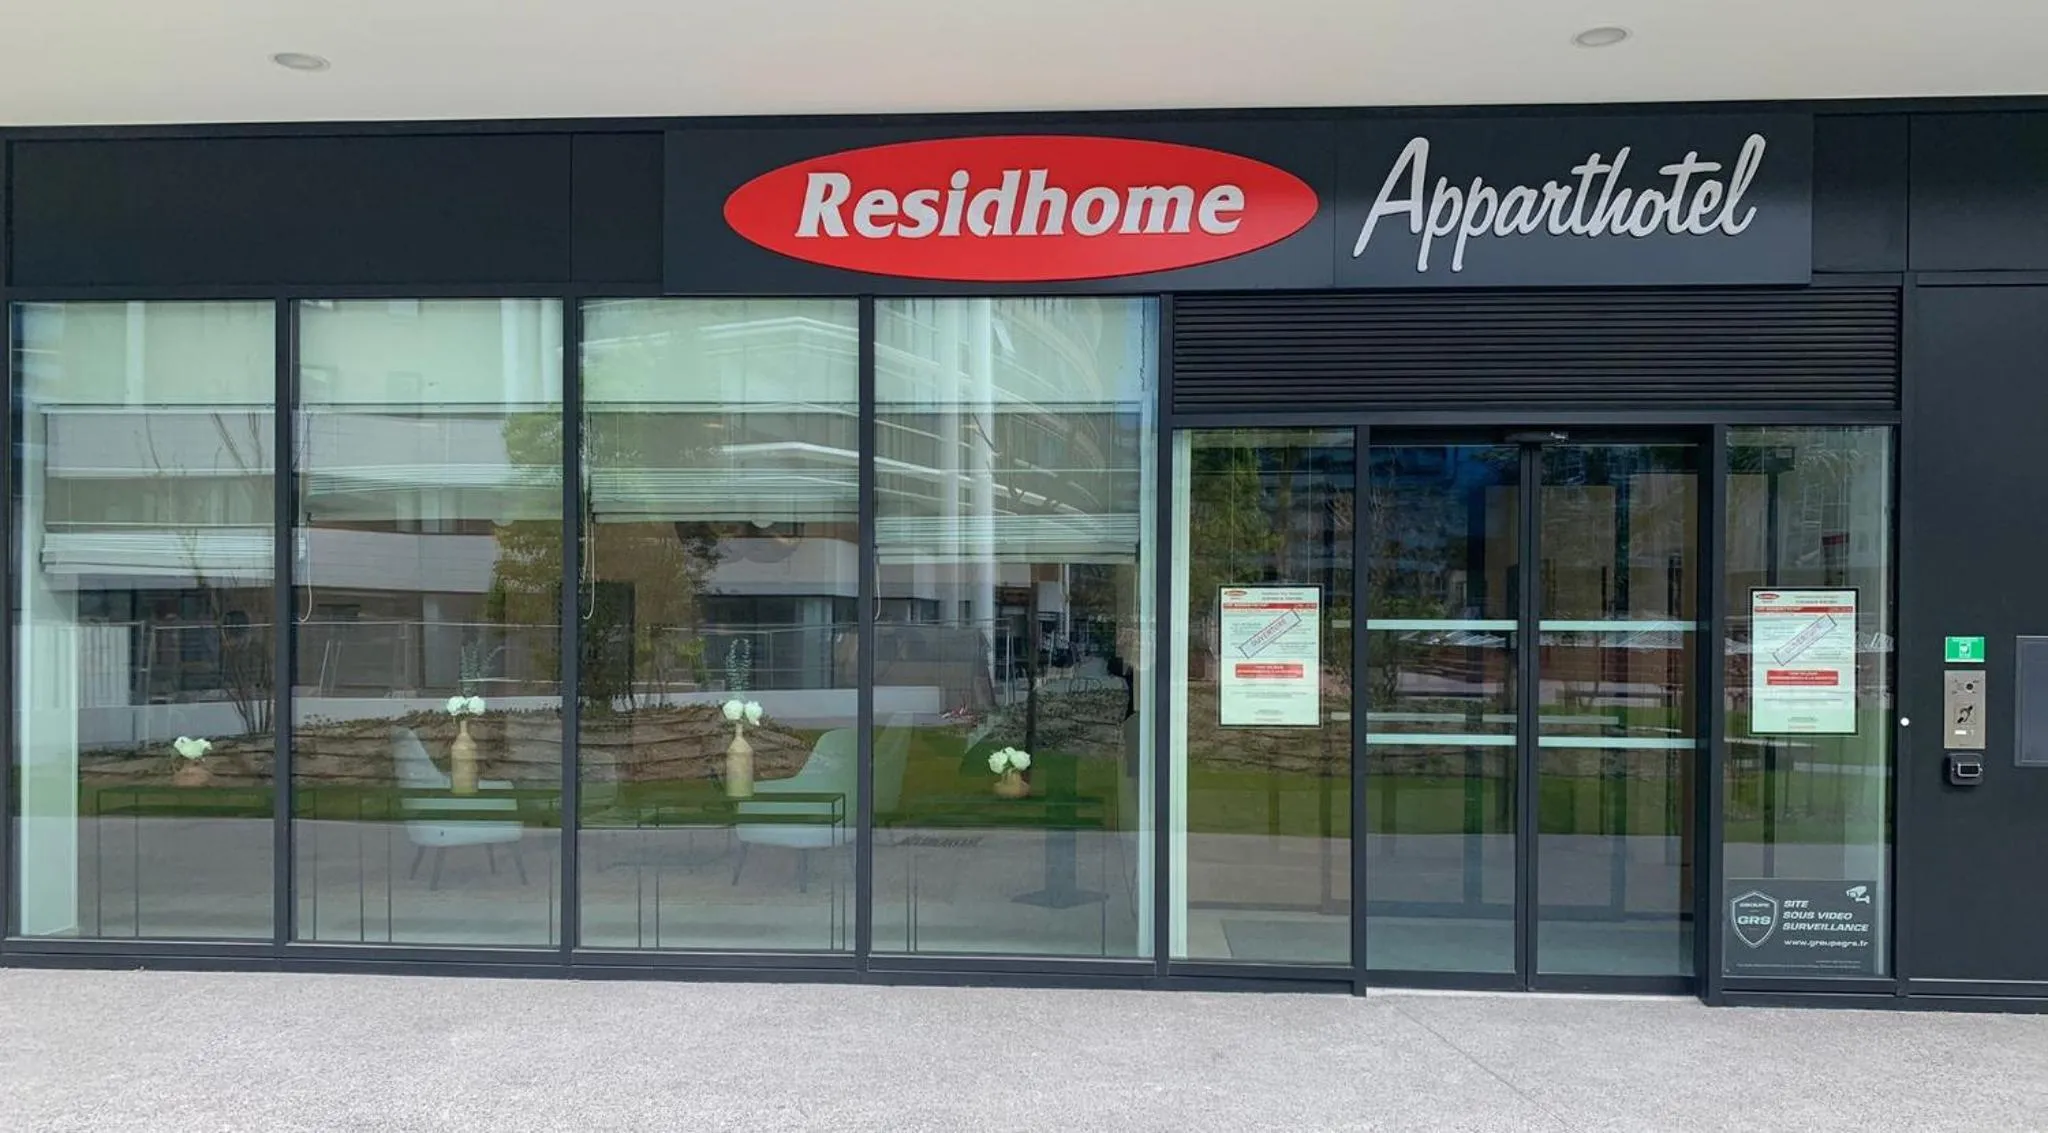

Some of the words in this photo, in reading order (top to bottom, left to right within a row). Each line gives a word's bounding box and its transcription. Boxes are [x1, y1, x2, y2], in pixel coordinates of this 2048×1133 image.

[795, 169, 1246, 239] Residhome
[1352, 133, 1767, 273] Apparthotel
[1783, 900, 1809, 909] SITE
[1737, 915, 1771, 925] GRS
[1782, 911, 1815, 920] SOUS
[1817, 912, 1853, 921] VIDEO
[1782, 922, 1870, 932] SURVEILLANCE
